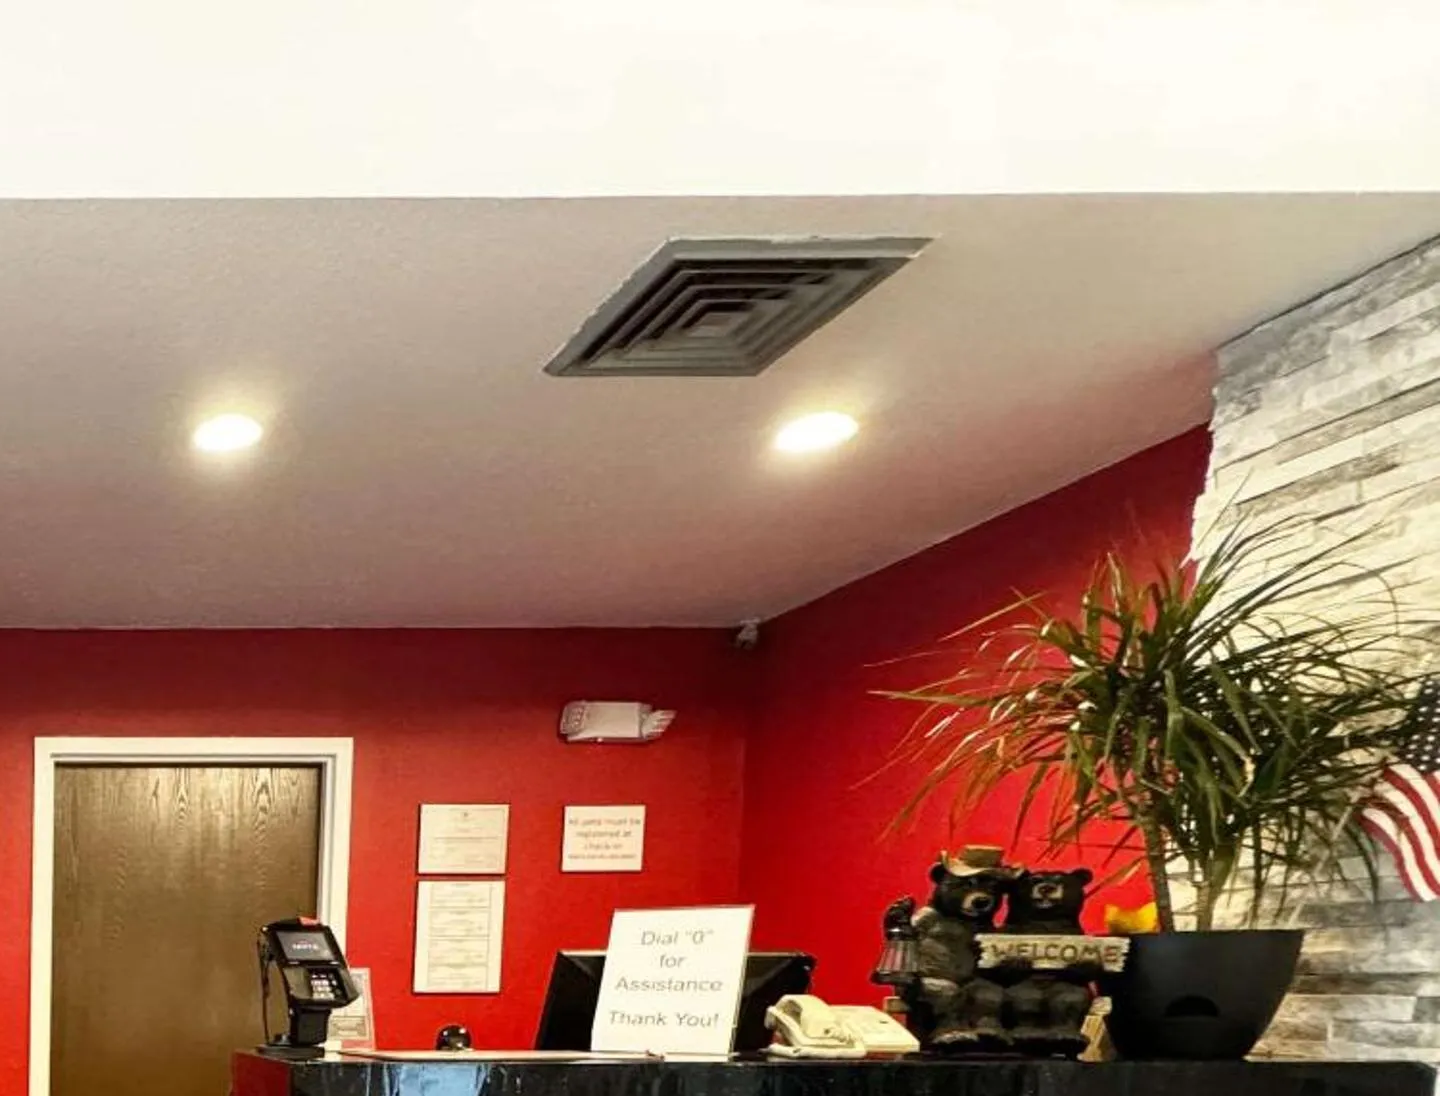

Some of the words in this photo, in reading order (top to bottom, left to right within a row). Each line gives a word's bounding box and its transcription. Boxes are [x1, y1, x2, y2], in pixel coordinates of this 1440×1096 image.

[640, 930, 679, 946] Dial
[659, 953, 687, 969] for
[989, 942, 1122, 964] WELCOME
[614, 975, 724, 993] Assistance
[608, 1010, 669, 1027] Thank
[675, 1011, 720, 1028] You!
